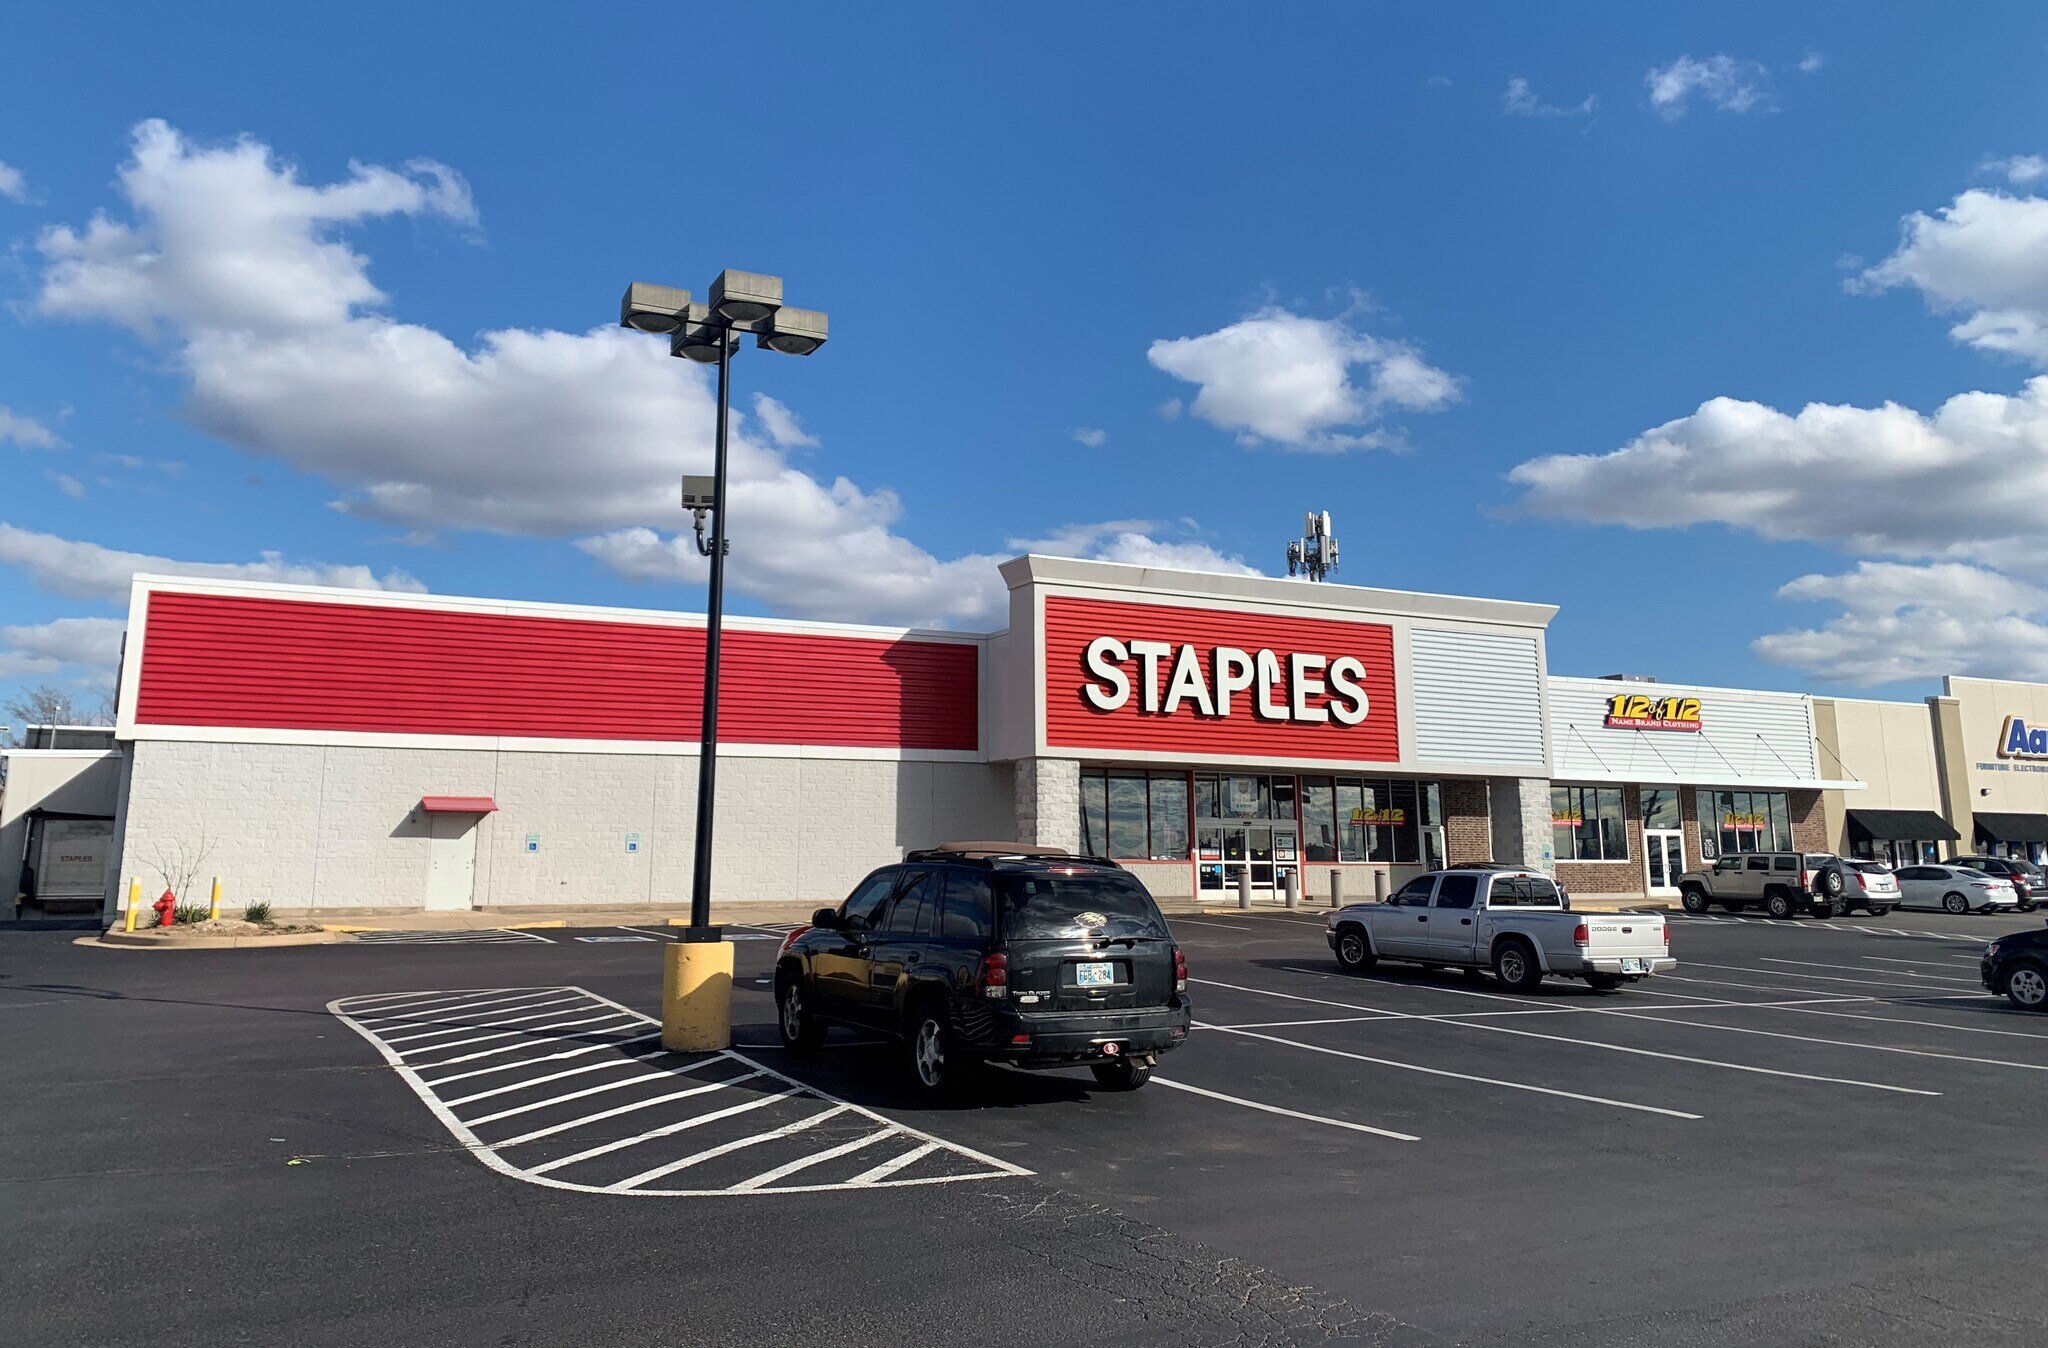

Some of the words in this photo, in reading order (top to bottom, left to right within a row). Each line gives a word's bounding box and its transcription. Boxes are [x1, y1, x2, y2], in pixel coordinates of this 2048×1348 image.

[1085, 636, 1370, 725] STAPLES
[1610, 694, 1650, 719] 1/2
[1648, 698, 1666, 720] of
[1663, 697, 1702, 720] 1/2
[1635, 719, 1661, 727] BRAND
[2006, 718, 2048, 754] Aa
